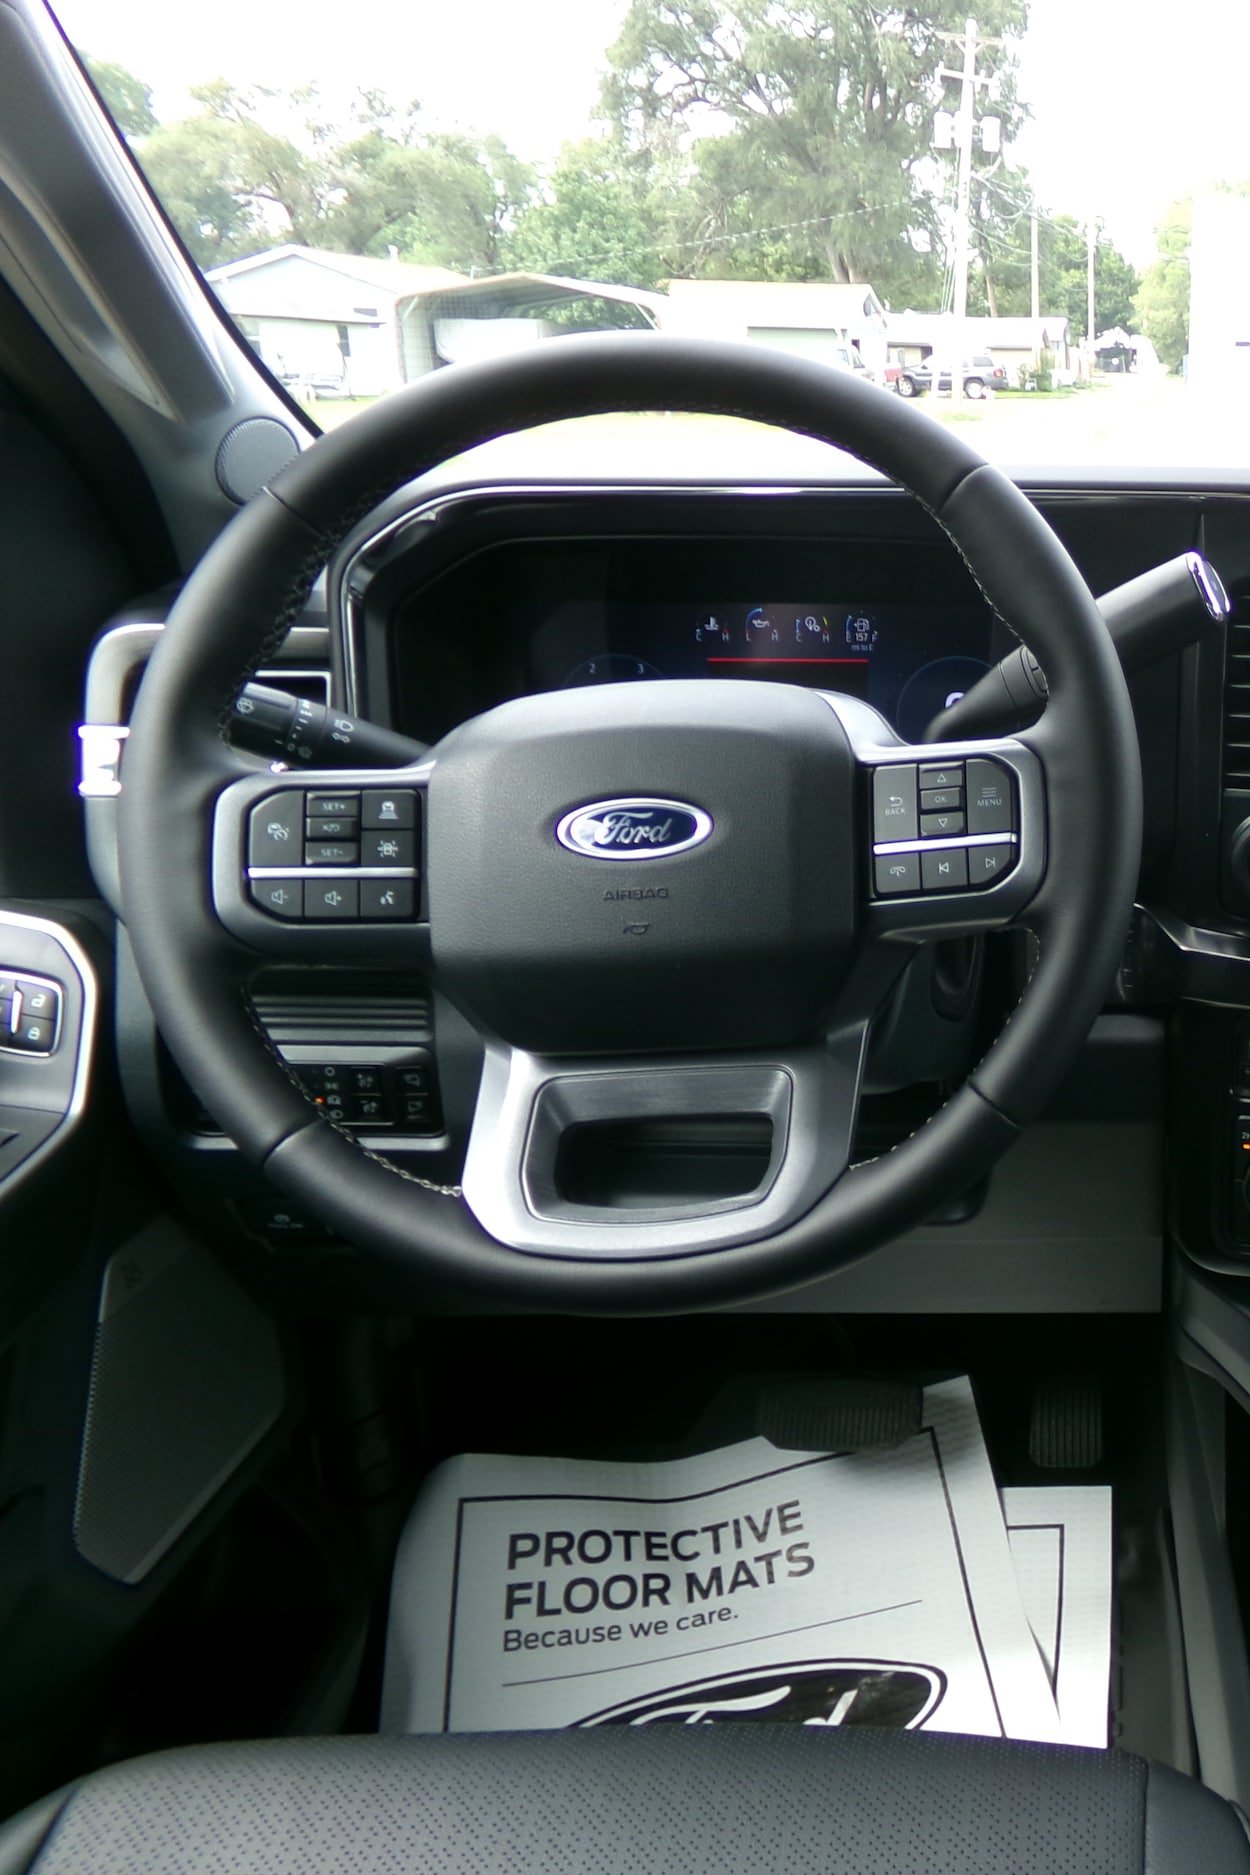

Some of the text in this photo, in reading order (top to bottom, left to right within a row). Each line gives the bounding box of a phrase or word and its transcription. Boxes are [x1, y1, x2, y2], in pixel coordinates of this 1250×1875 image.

[854, 632, 868, 643] 157
[588, 662, 596, 674] 2
[636, 662, 645, 674] 3
[934, 795, 946, 803] OK
[976, 798, 1002, 808] MENU
[884, 807, 906, 817] BACK
[594, 811, 673, 846] Ford
[602, 887, 670, 901] AIRBAG
[506, 1499, 805, 1571] PROTECTIVE
[504, 1541, 816, 1620] FLOOR MATS
[502, 1606, 739, 1653] Because we care.
